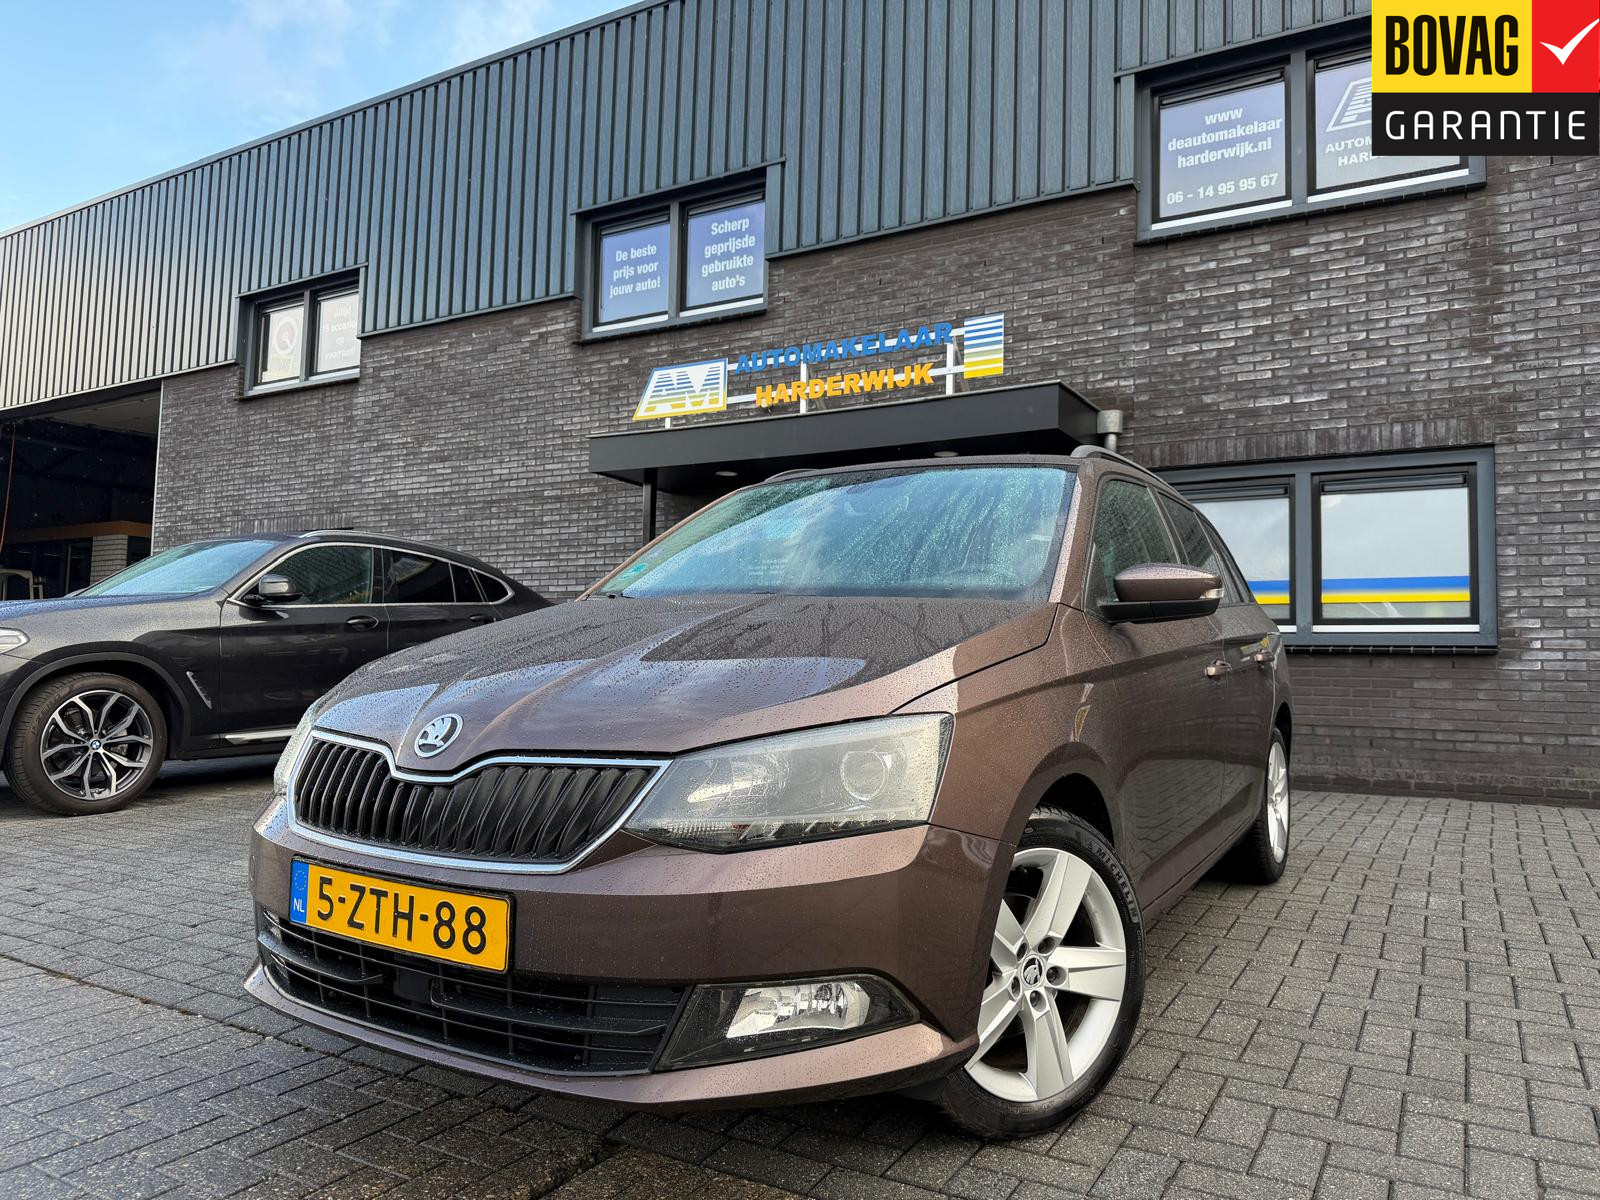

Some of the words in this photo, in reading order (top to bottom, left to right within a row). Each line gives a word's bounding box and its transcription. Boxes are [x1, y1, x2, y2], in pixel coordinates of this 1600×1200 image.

[1204, 106, 1244, 126] www
[1167, 117, 1282, 152] deautomakelaar
[1177, 137, 1273, 169] harderwijk.nl
[1166, 190, 1185, 205] 06
[1197, 184, 1214, 200] 14
[1216, 180, 1237, 197] 95
[1238, 176, 1258, 193] 95
[1259, 172, 1279, 190] 67
[711, 217, 750, 236] Scherp
[615, 249, 628, 262] De
[630, 243, 657, 259] beste
[704, 234, 756, 258] geprijsde
[613, 264, 635, 282] prijs
[636, 260, 659, 275] voor
[702, 253, 754, 277] gebruikte
[609, 281, 634, 299] jouw
[635, 276, 661, 292] auto!
[711, 274, 746, 292] auto's
[734, 321, 953, 376] AUTOMAKELAAR
[755, 362, 935, 408] HARDERWIJK
[1096, 848, 1138, 919] MICHELIN
[293, 897, 305, 913] NL
[317, 875, 487, 955] 5-ZTH-88
